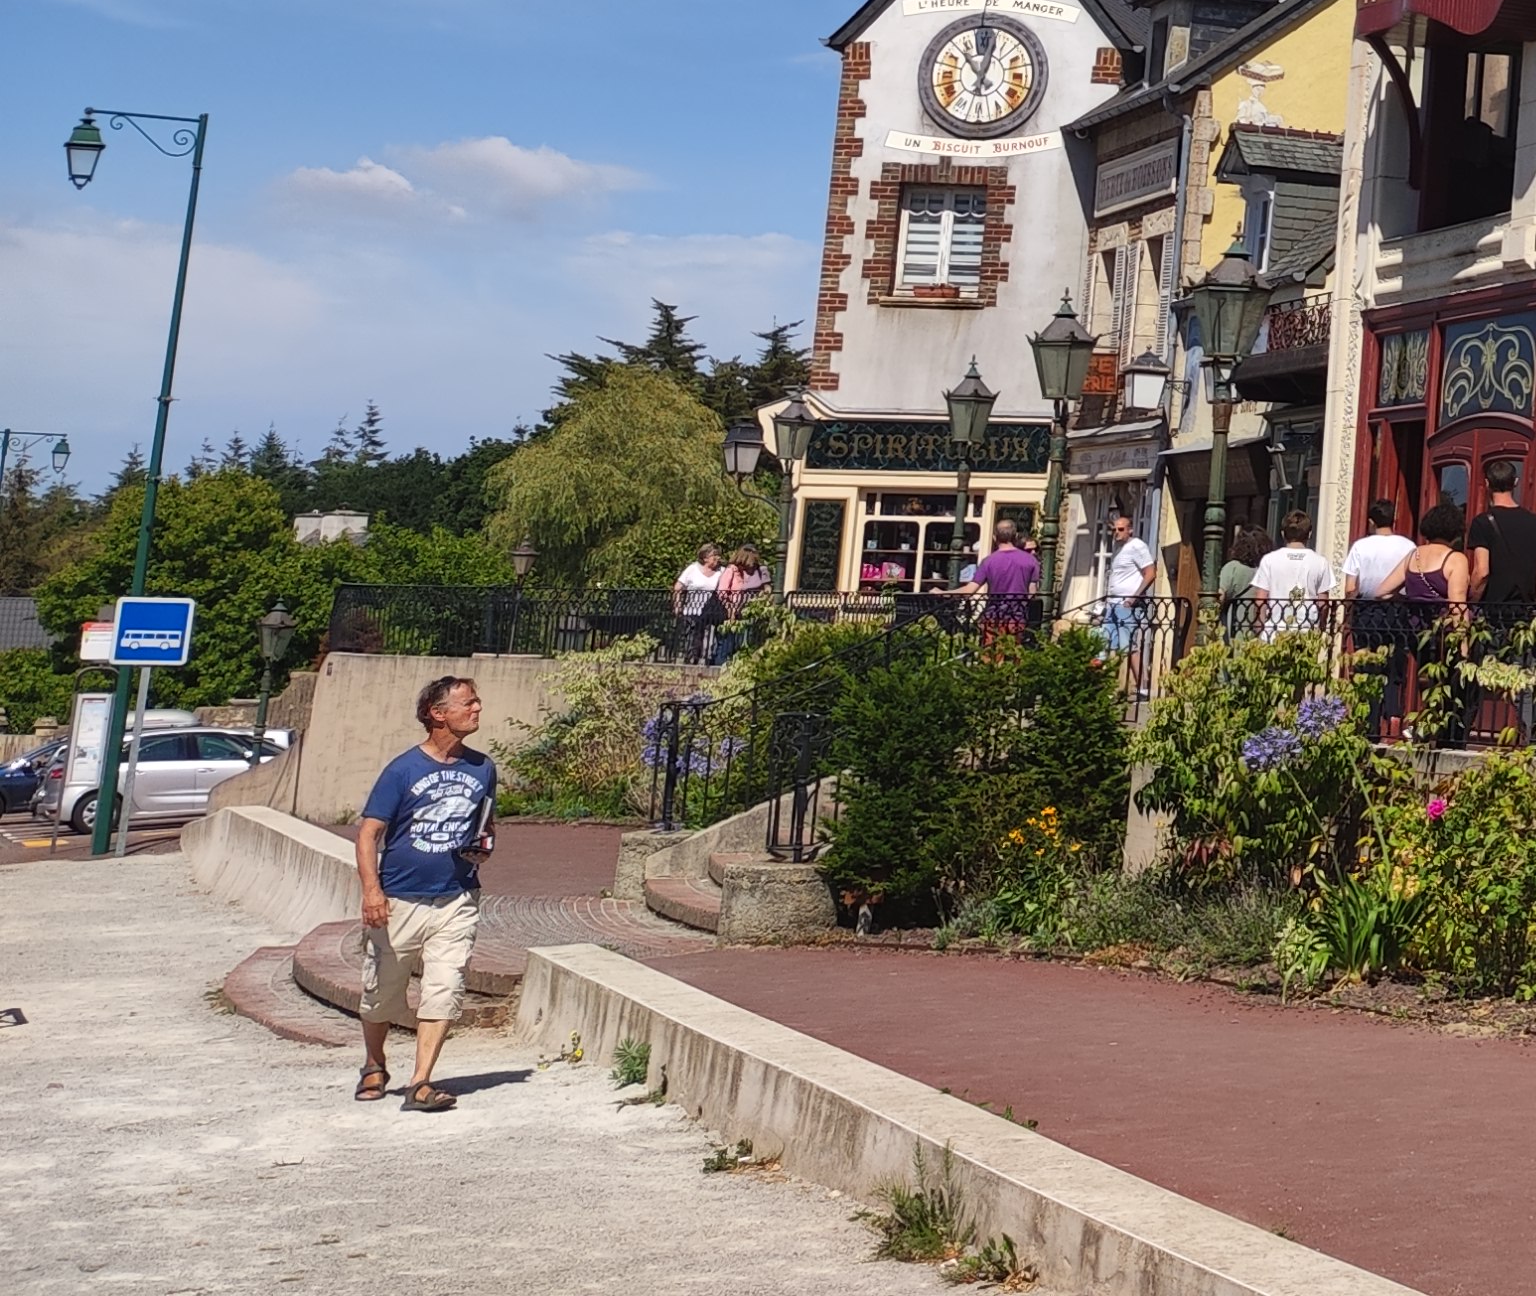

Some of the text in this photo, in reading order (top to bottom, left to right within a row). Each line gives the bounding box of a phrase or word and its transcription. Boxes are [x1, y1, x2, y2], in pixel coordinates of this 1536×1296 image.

[1013, 0, 1064, 16] MANGER
[904, 137, 1050, 154] UN BISCUIT BURNOUF
[456, 771, 484, 792] STREET
